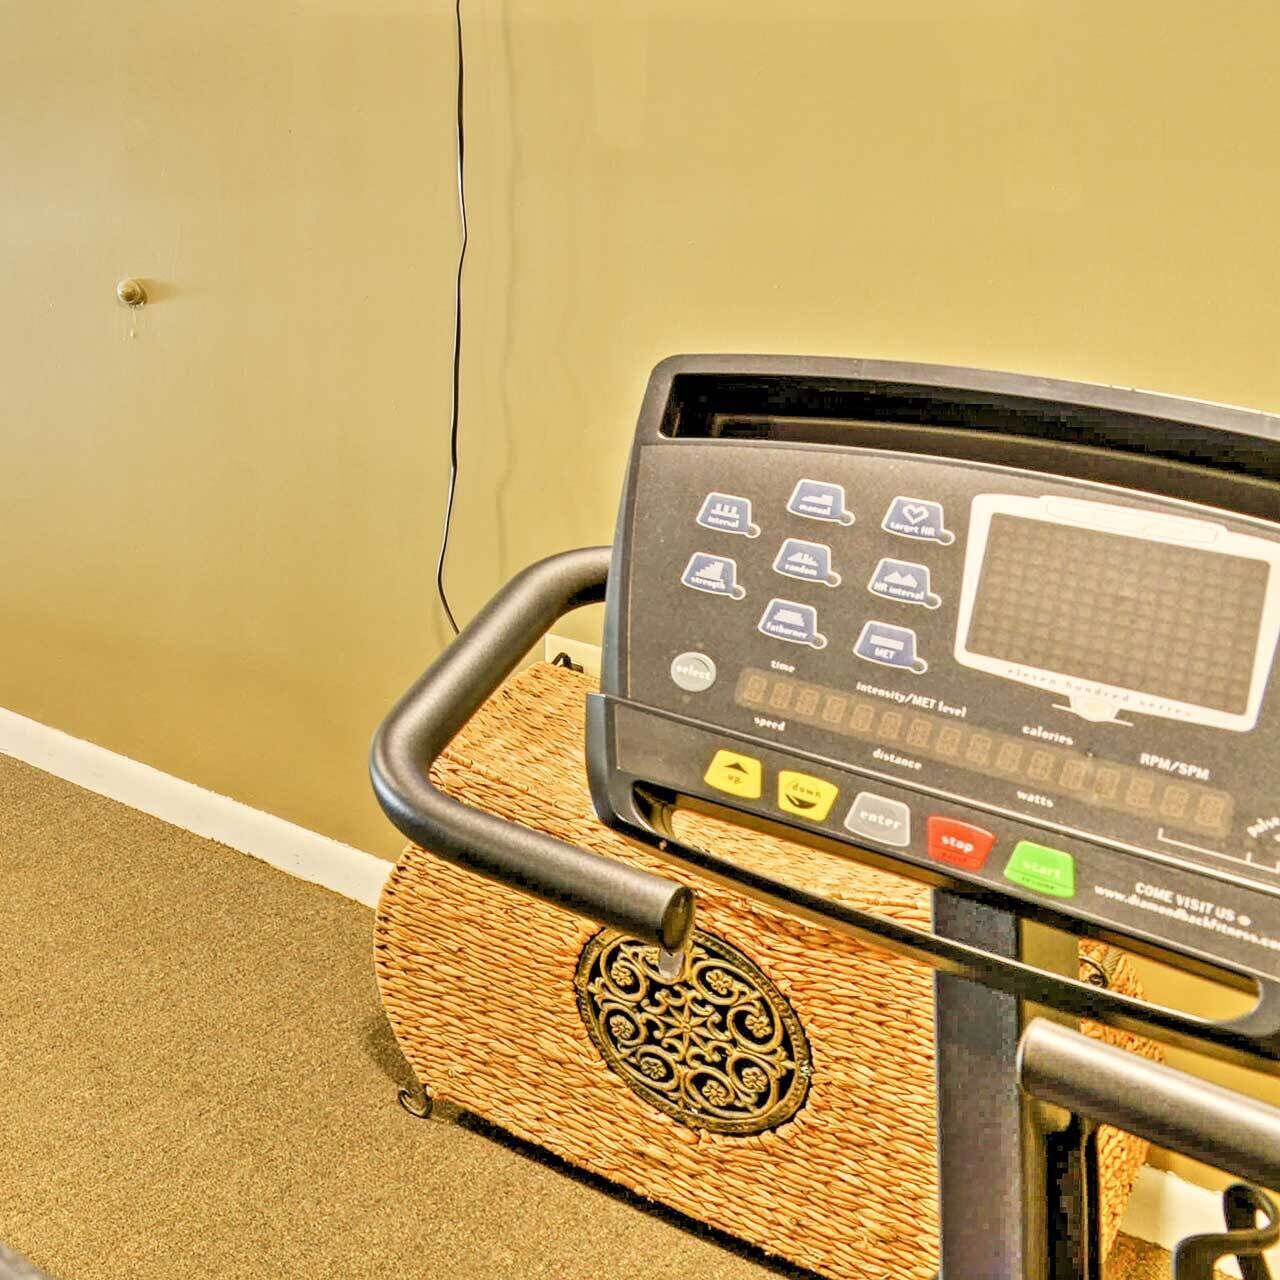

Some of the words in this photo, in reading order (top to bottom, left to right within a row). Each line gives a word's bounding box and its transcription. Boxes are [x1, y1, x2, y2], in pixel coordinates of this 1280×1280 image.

[707, 514, 740, 528] interval
[890, 521, 920, 536] target
[784, 562, 818, 577] random
[690, 575, 727, 592] strength
[874, 580, 888, 593] HR
[890, 584, 925, 601] interval
[874, 647, 896, 660] MET
[675, 663, 713, 681] select
[770, 659, 796, 672] time
[856, 680, 936, 710] intensity/MET
[938, 701, 968, 718] level
[1066, 679, 1130, 703] hundred
[753, 715, 786, 732] speed
[1021, 724, 1074, 746] calories
[872, 747, 922, 770] distance
[1139, 751, 1211, 782] RPM/SPM
[792, 781, 822, 799] down
[1016, 788, 1055, 809] watts
[859, 808, 903, 831] enter
[940, 834, 974, 854] stop
[1022, 859, 1063, 881] start
[1134, 881, 1175, 905] COME
[1175, 893, 1215, 915] VISIT
[1214, 905, 1237, 923] US
